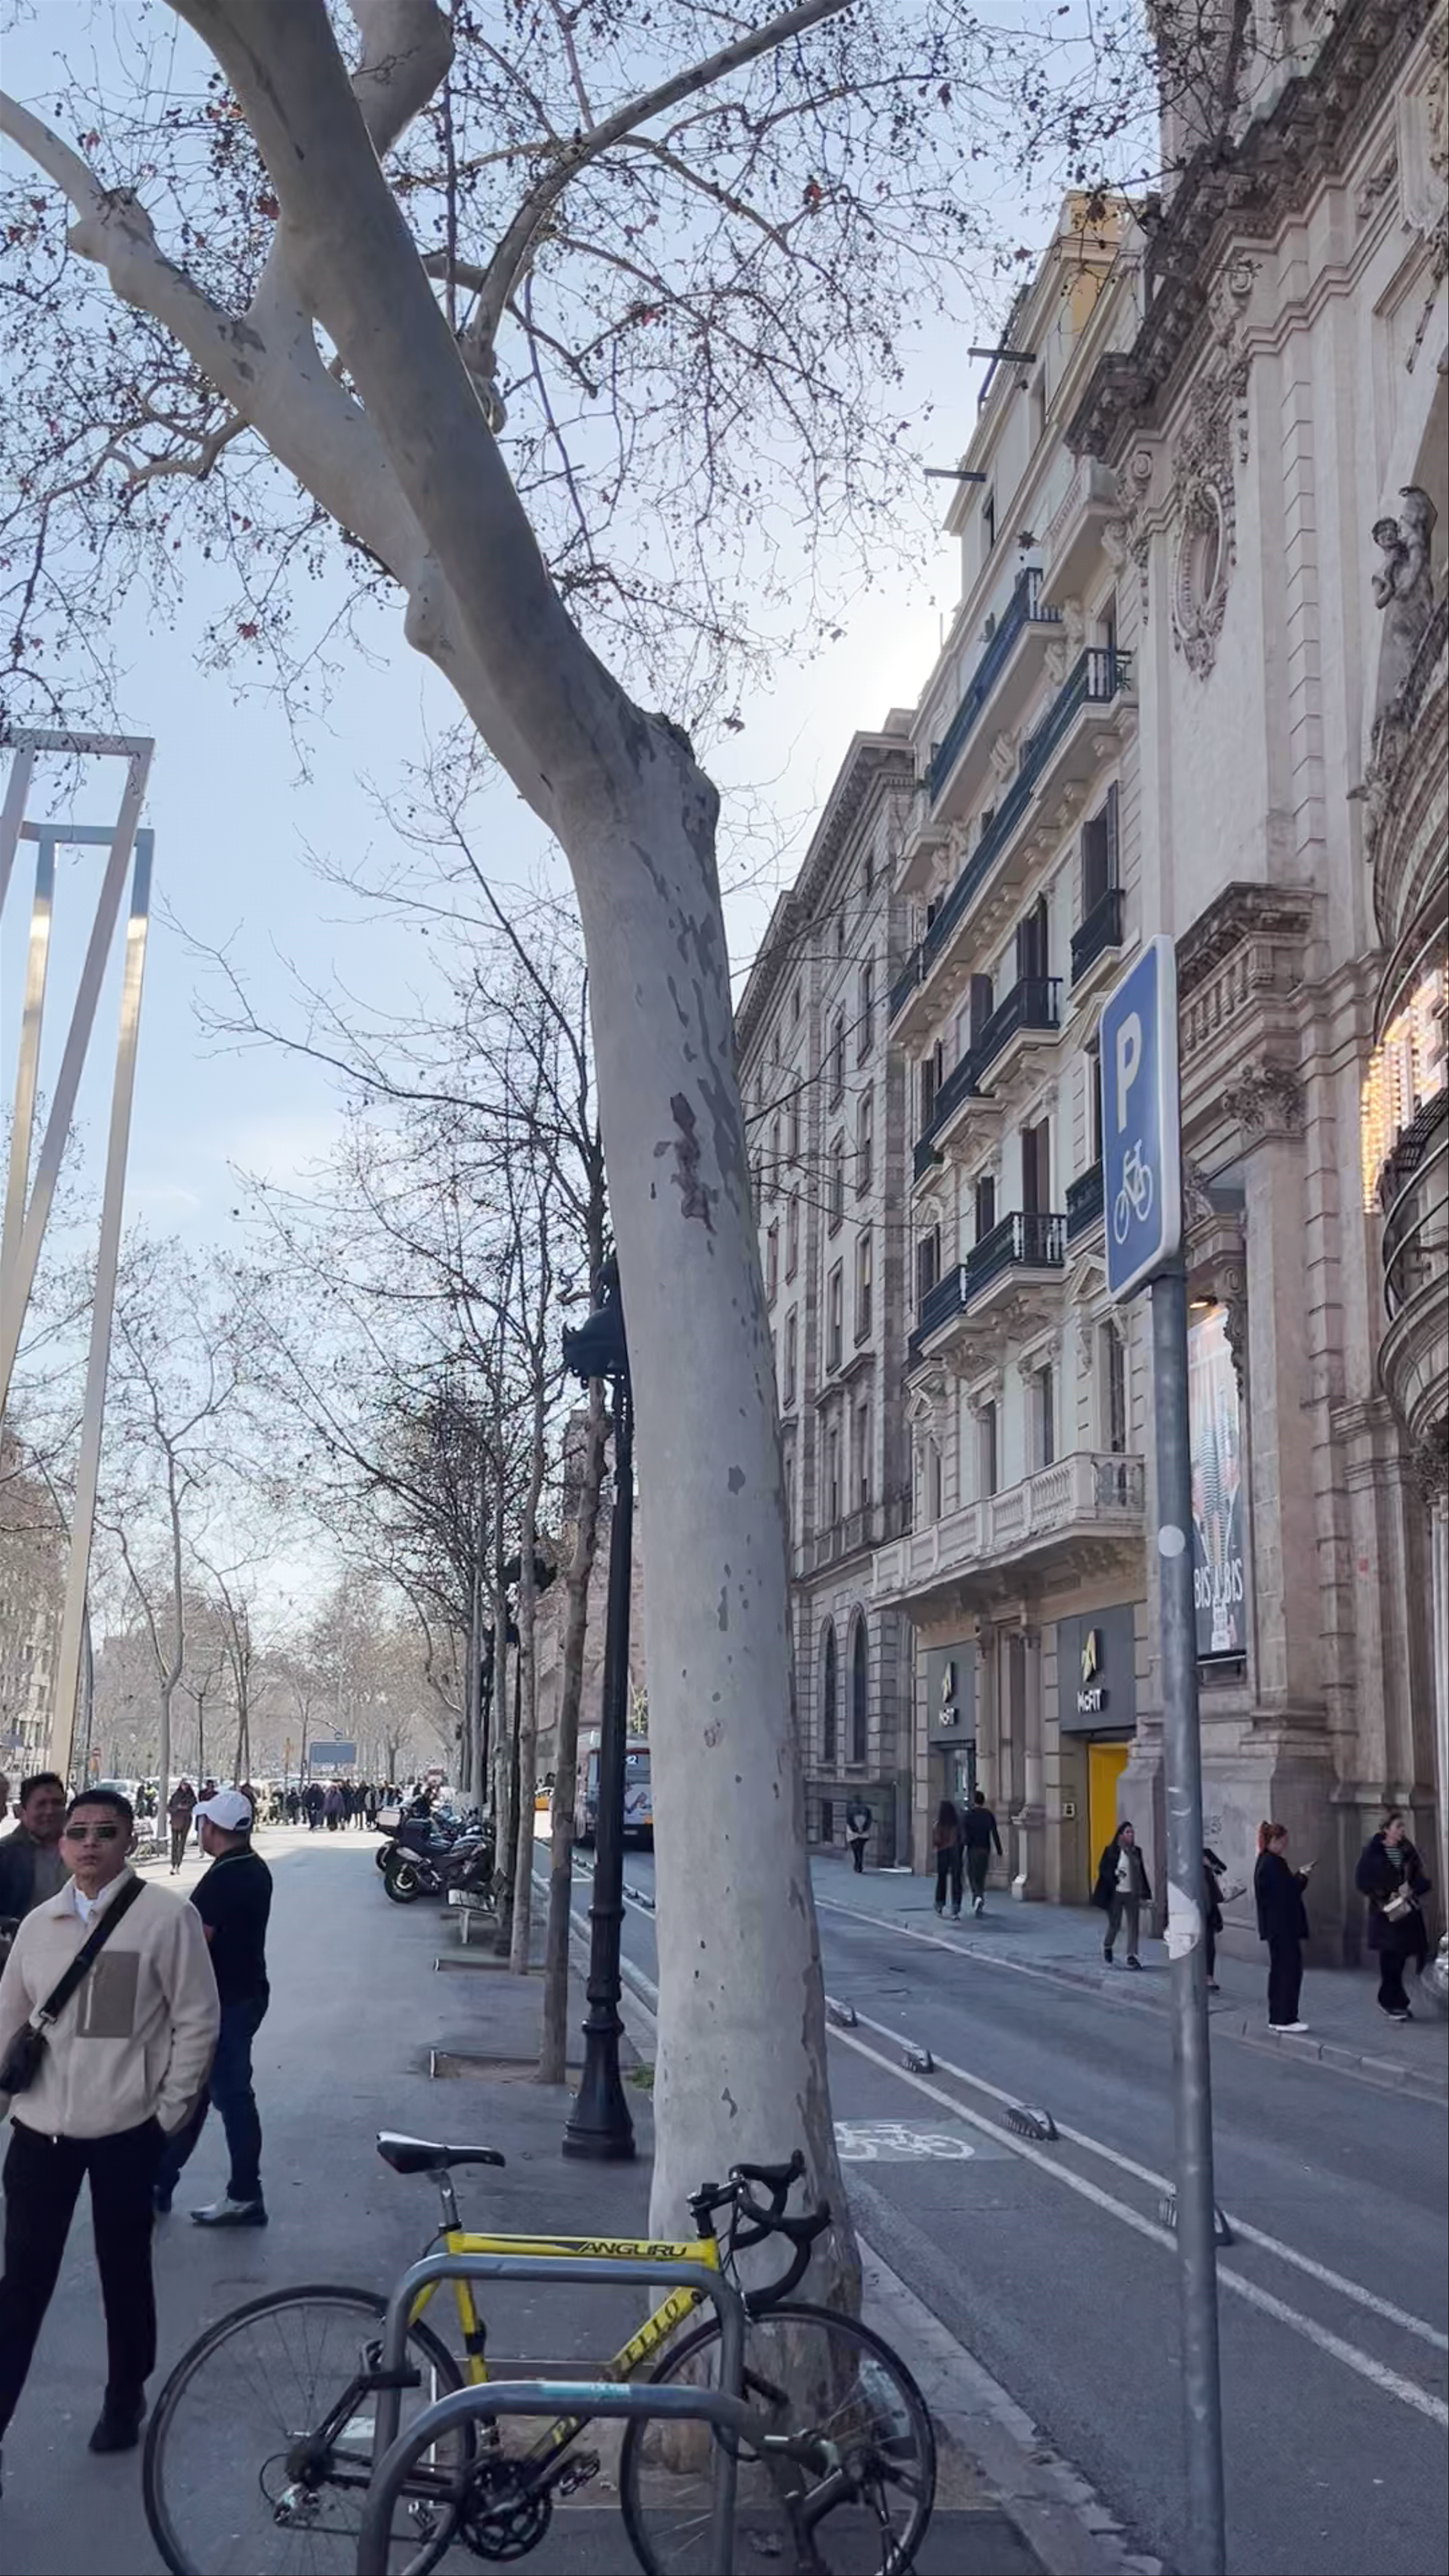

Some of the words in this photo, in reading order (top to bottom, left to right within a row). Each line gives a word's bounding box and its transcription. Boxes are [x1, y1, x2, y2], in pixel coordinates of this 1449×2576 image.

[1116, 1012, 1142, 1133] P
[1193, 1565, 1211, 1610] BIS
[1224, 1558, 1243, 1604] BIS
